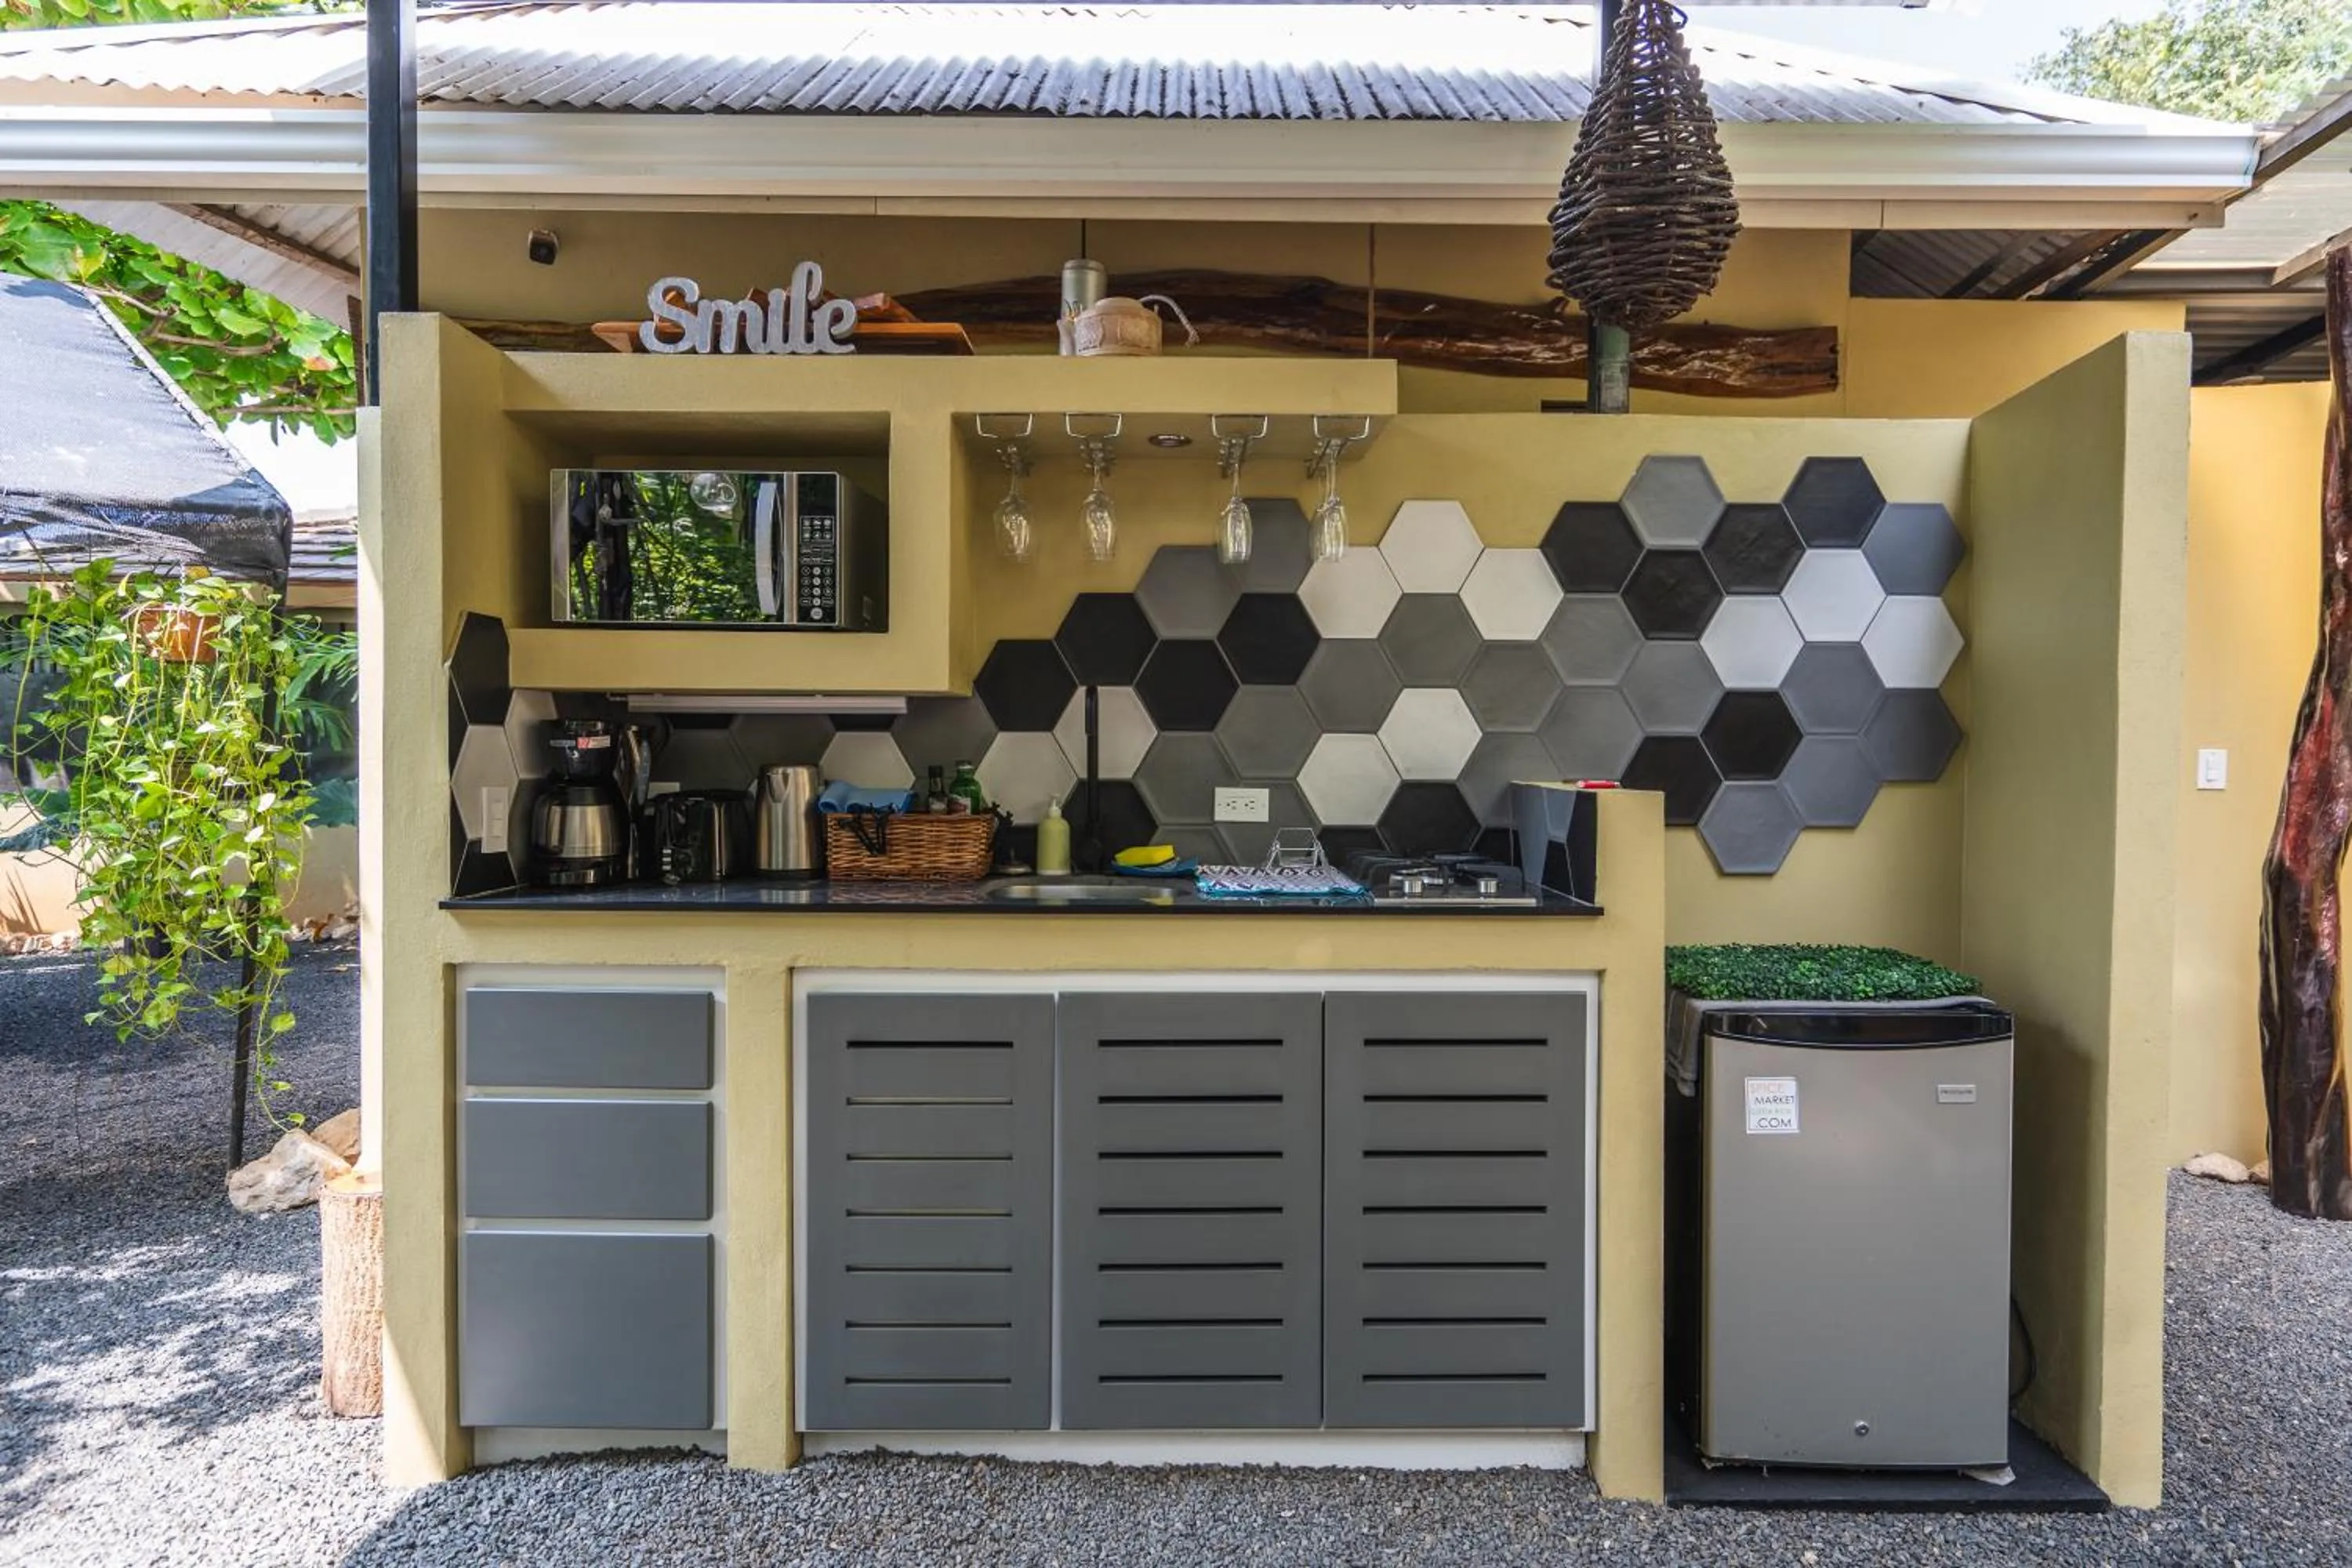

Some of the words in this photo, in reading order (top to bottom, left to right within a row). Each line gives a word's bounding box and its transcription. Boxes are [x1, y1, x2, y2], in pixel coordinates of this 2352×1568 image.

[639, 261, 857, 354] Smile
[1755, 1095, 1795, 1105] MARKET
[1755, 1117, 1792, 1128] .COM
